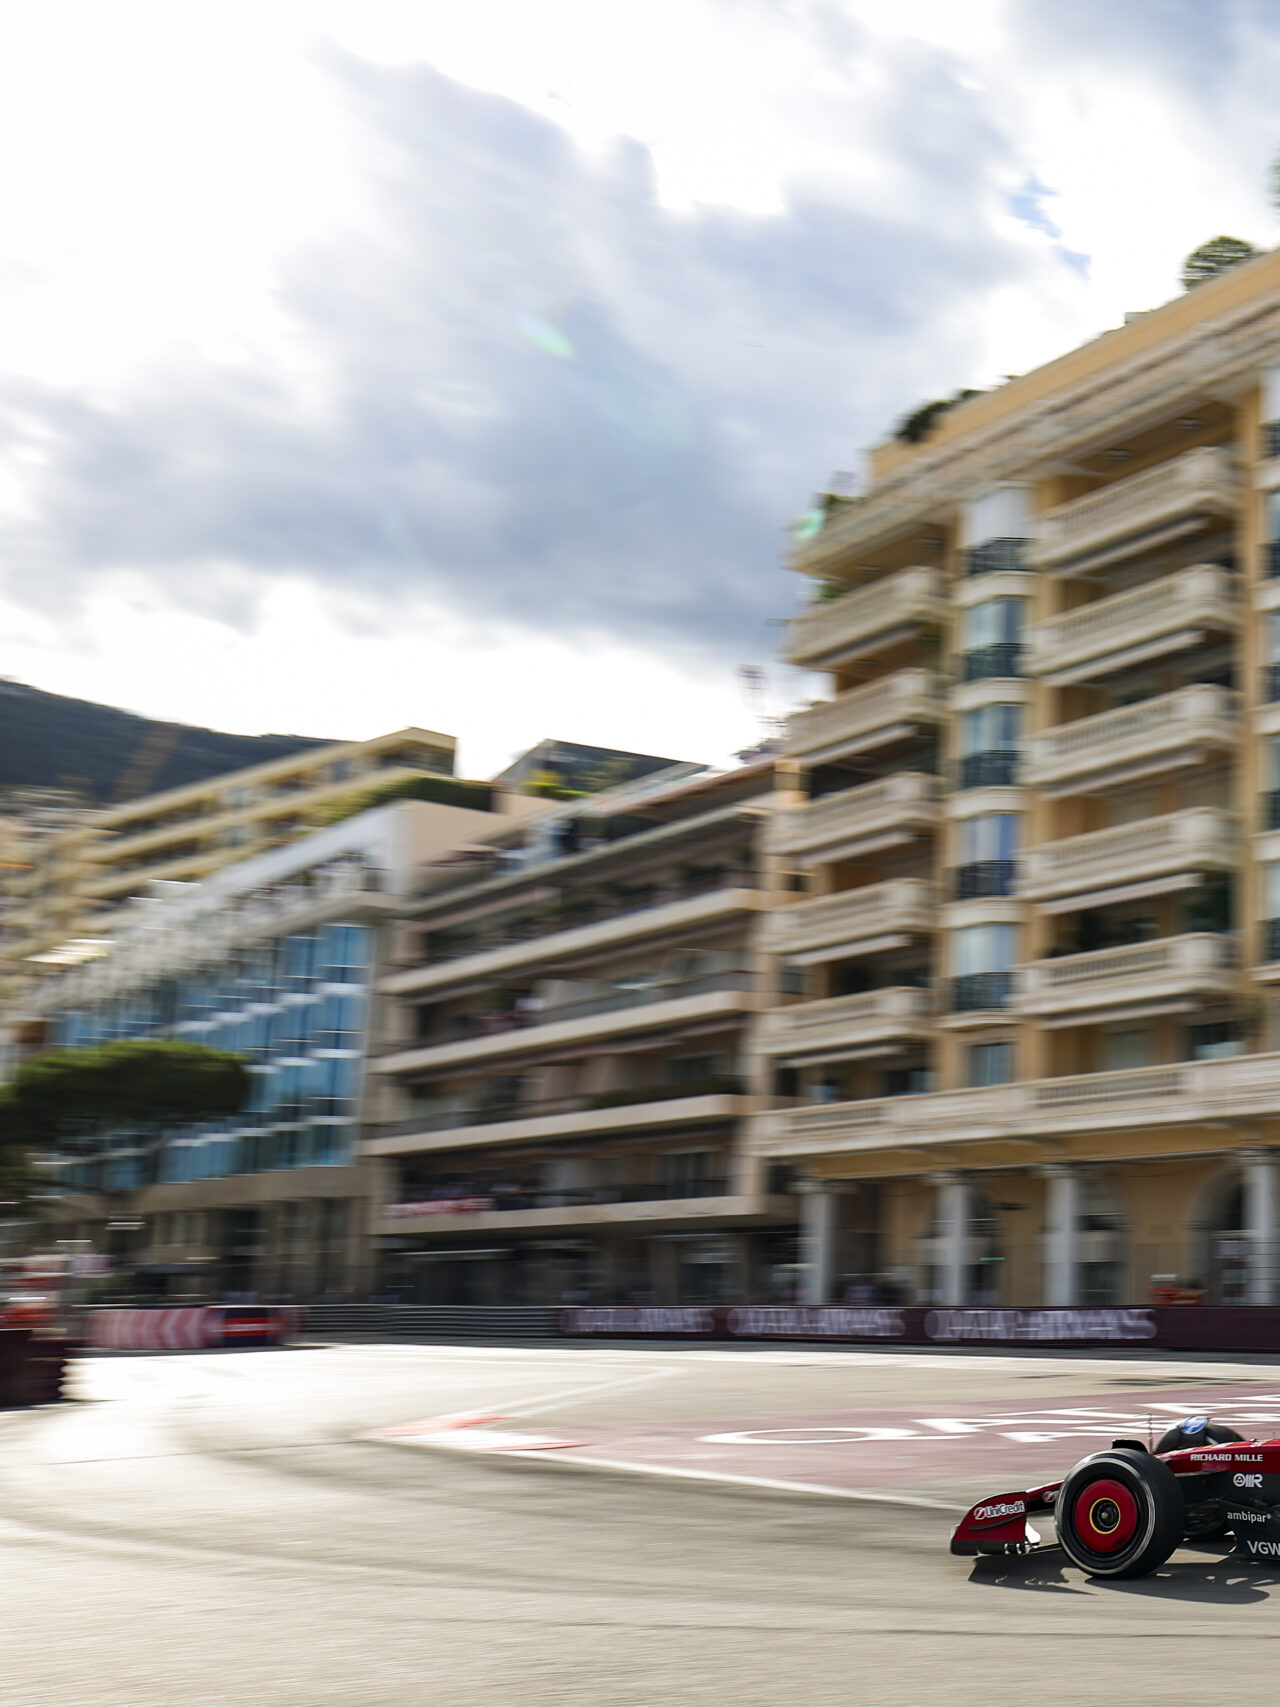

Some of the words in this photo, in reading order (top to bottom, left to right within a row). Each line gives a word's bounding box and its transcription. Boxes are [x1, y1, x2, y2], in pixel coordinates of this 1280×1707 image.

[1190, 1453, 1232, 1461] RICHARD
[985, 1500, 1025, 1518] UniCredit
[1247, 1540, 1280, 1556] VGW
